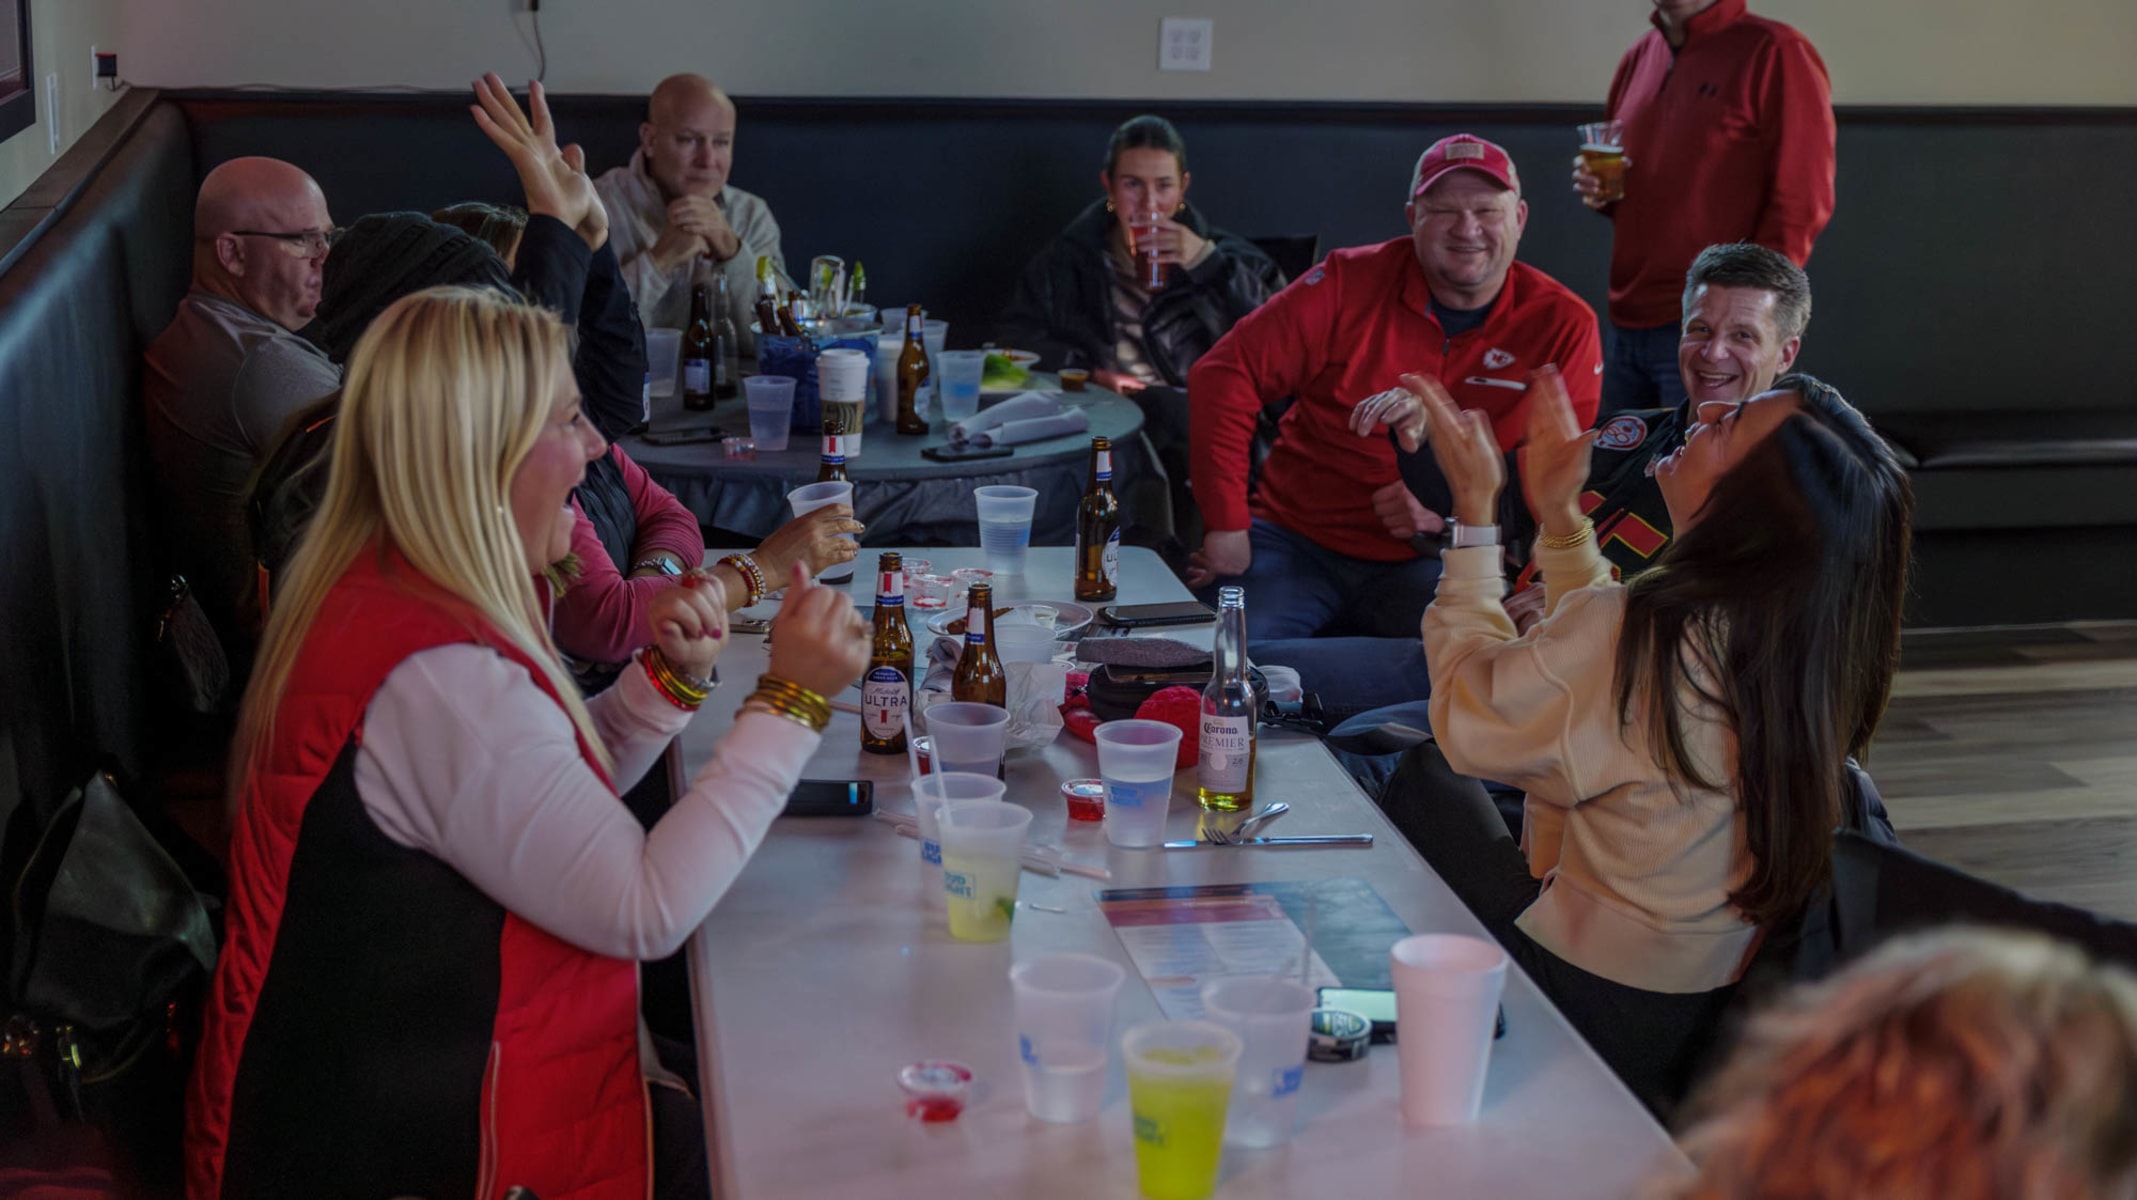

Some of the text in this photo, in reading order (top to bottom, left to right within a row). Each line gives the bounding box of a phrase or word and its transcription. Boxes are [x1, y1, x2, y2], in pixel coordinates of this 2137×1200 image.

[864, 695, 908, 708] ULTRA
[1203, 722, 1238, 735] Corona
[1200, 735, 1245, 749] PREMIER
